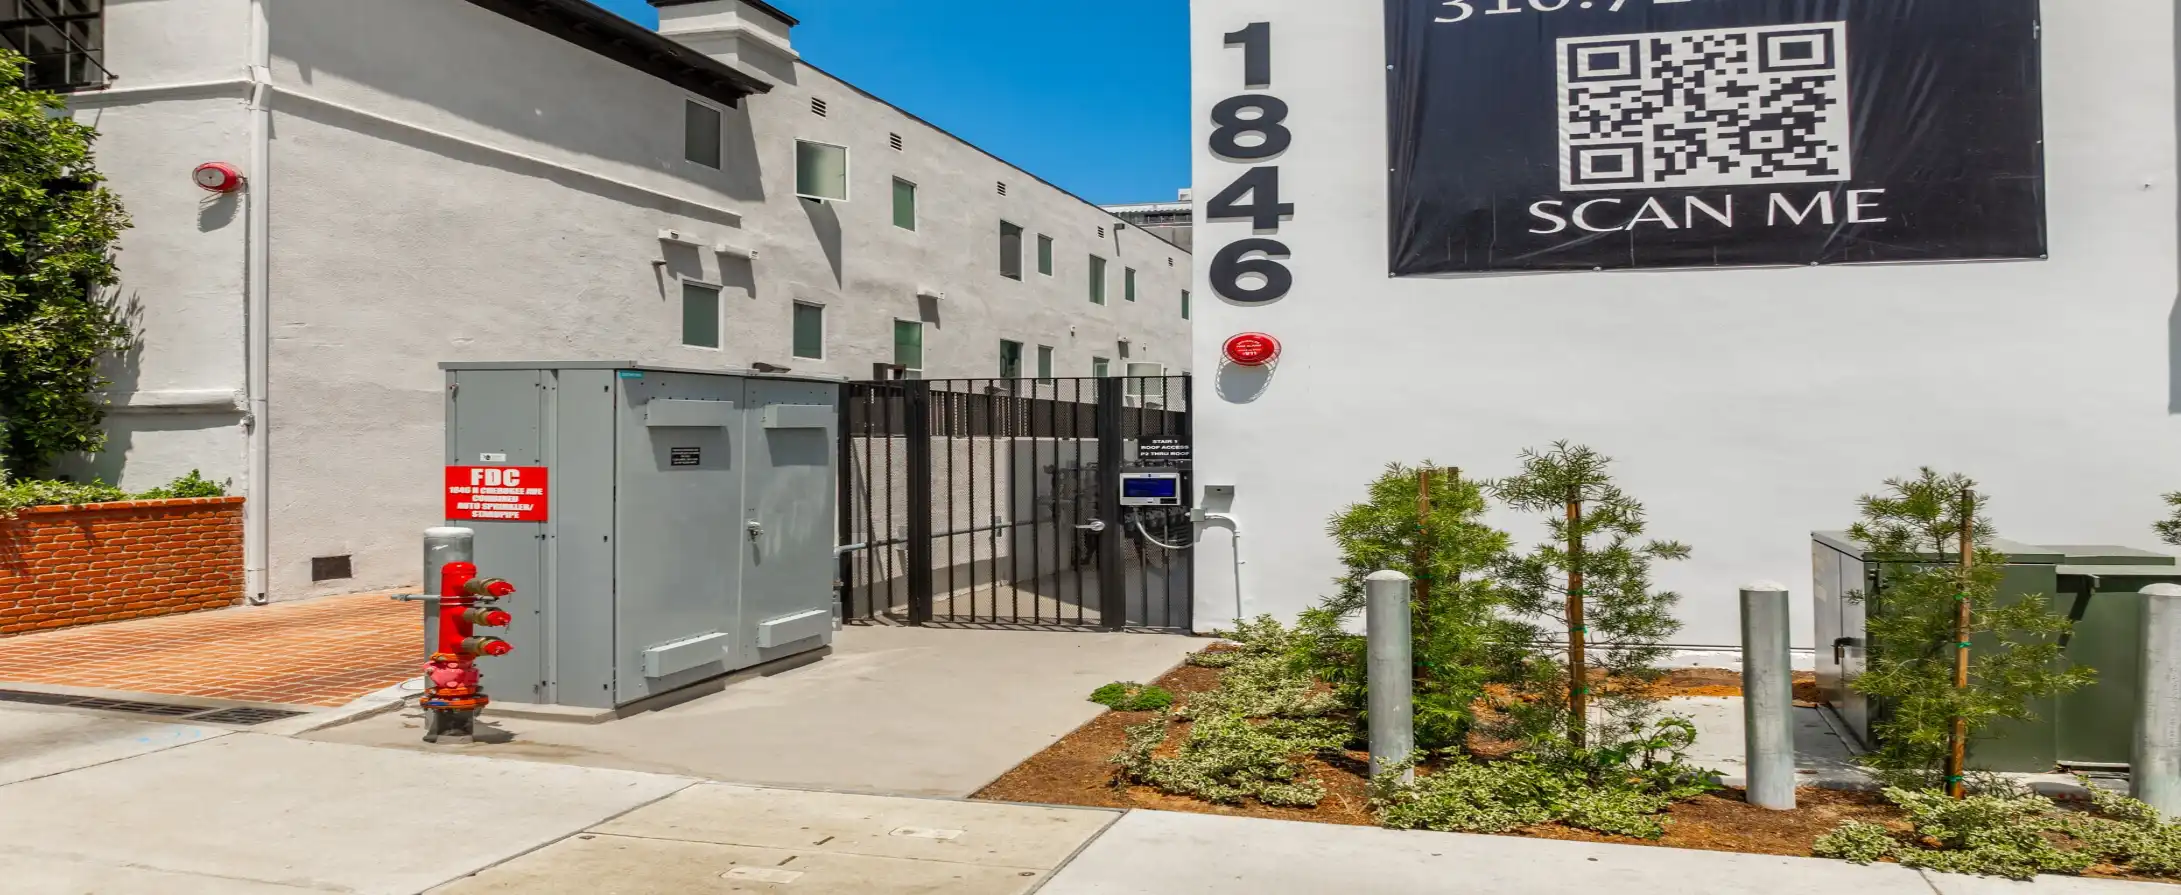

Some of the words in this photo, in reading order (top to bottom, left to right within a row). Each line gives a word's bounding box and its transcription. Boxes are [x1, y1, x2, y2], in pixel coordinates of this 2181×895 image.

[1206, 21, 1295, 306] 1846
[1528, 194, 1733, 234] SCAN
[1767, 188, 1888, 227] ME
[470, 468, 521, 487] FDC
[456, 502, 481, 510] AUTO
